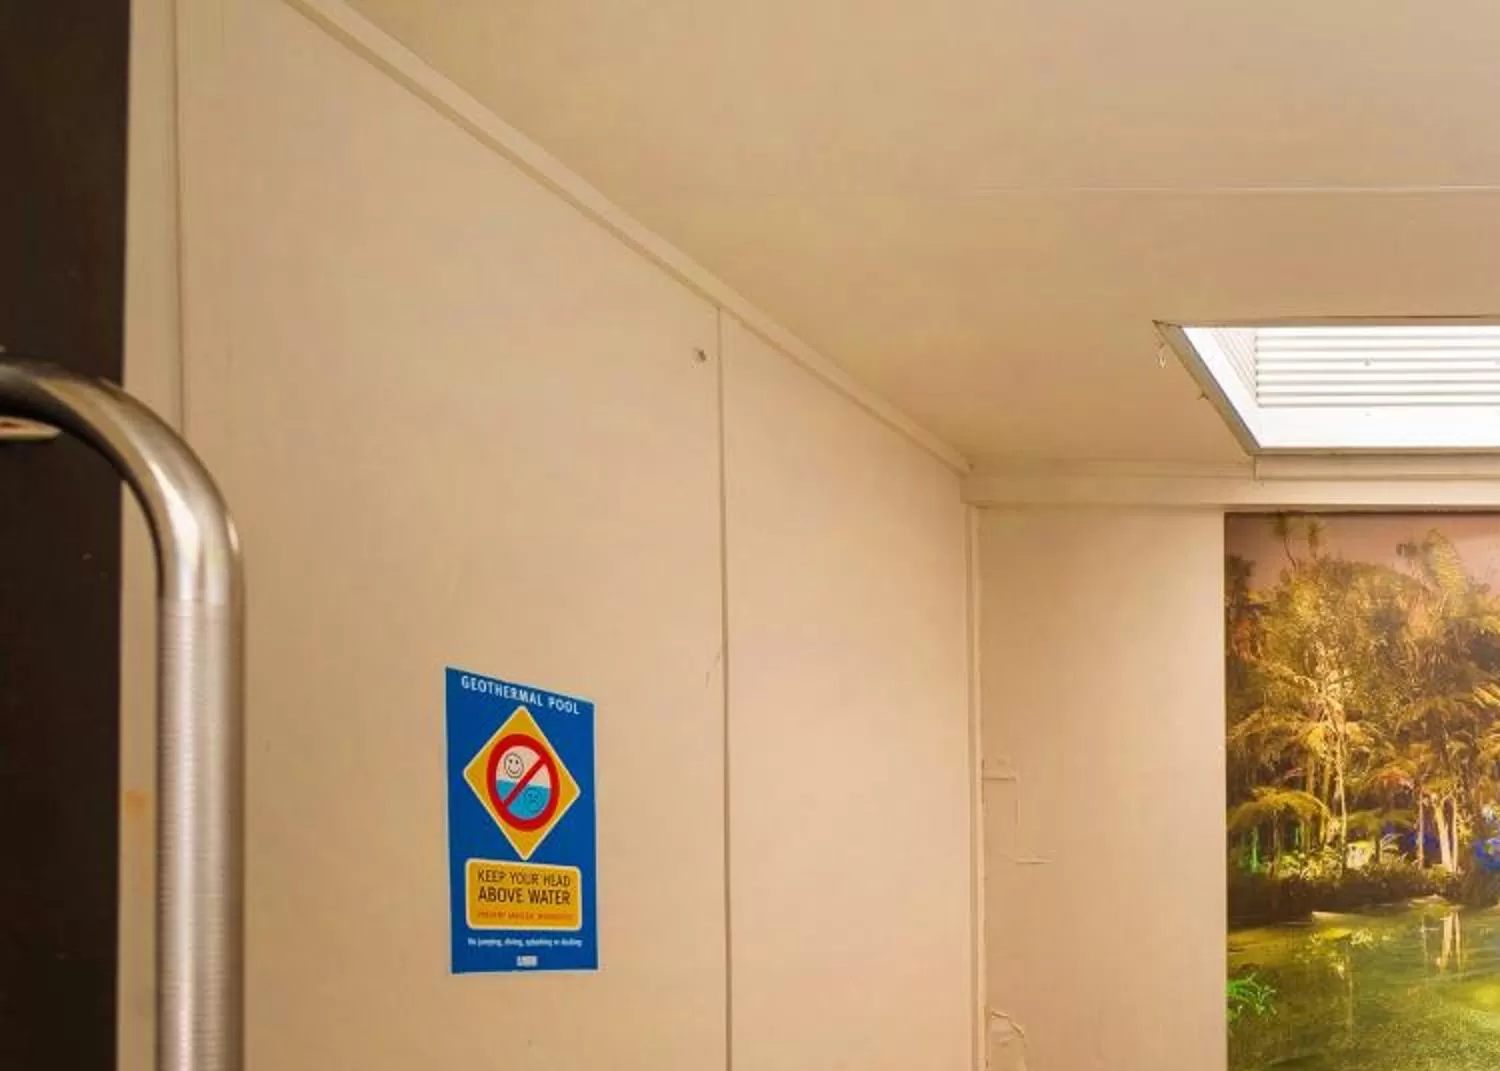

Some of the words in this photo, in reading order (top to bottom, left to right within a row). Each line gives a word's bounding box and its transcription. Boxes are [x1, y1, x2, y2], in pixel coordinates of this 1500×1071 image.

[461, 676, 544, 707] GEOTHERMAL
[549, 697, 580, 715] POOL
[478, 869, 506, 883] KEEP
[510, 872, 539, 886] YOUR
[543, 875, 571, 887] HEAD
[478, 887, 523, 903] ABOVE
[528, 889, 571, 906] WATER
